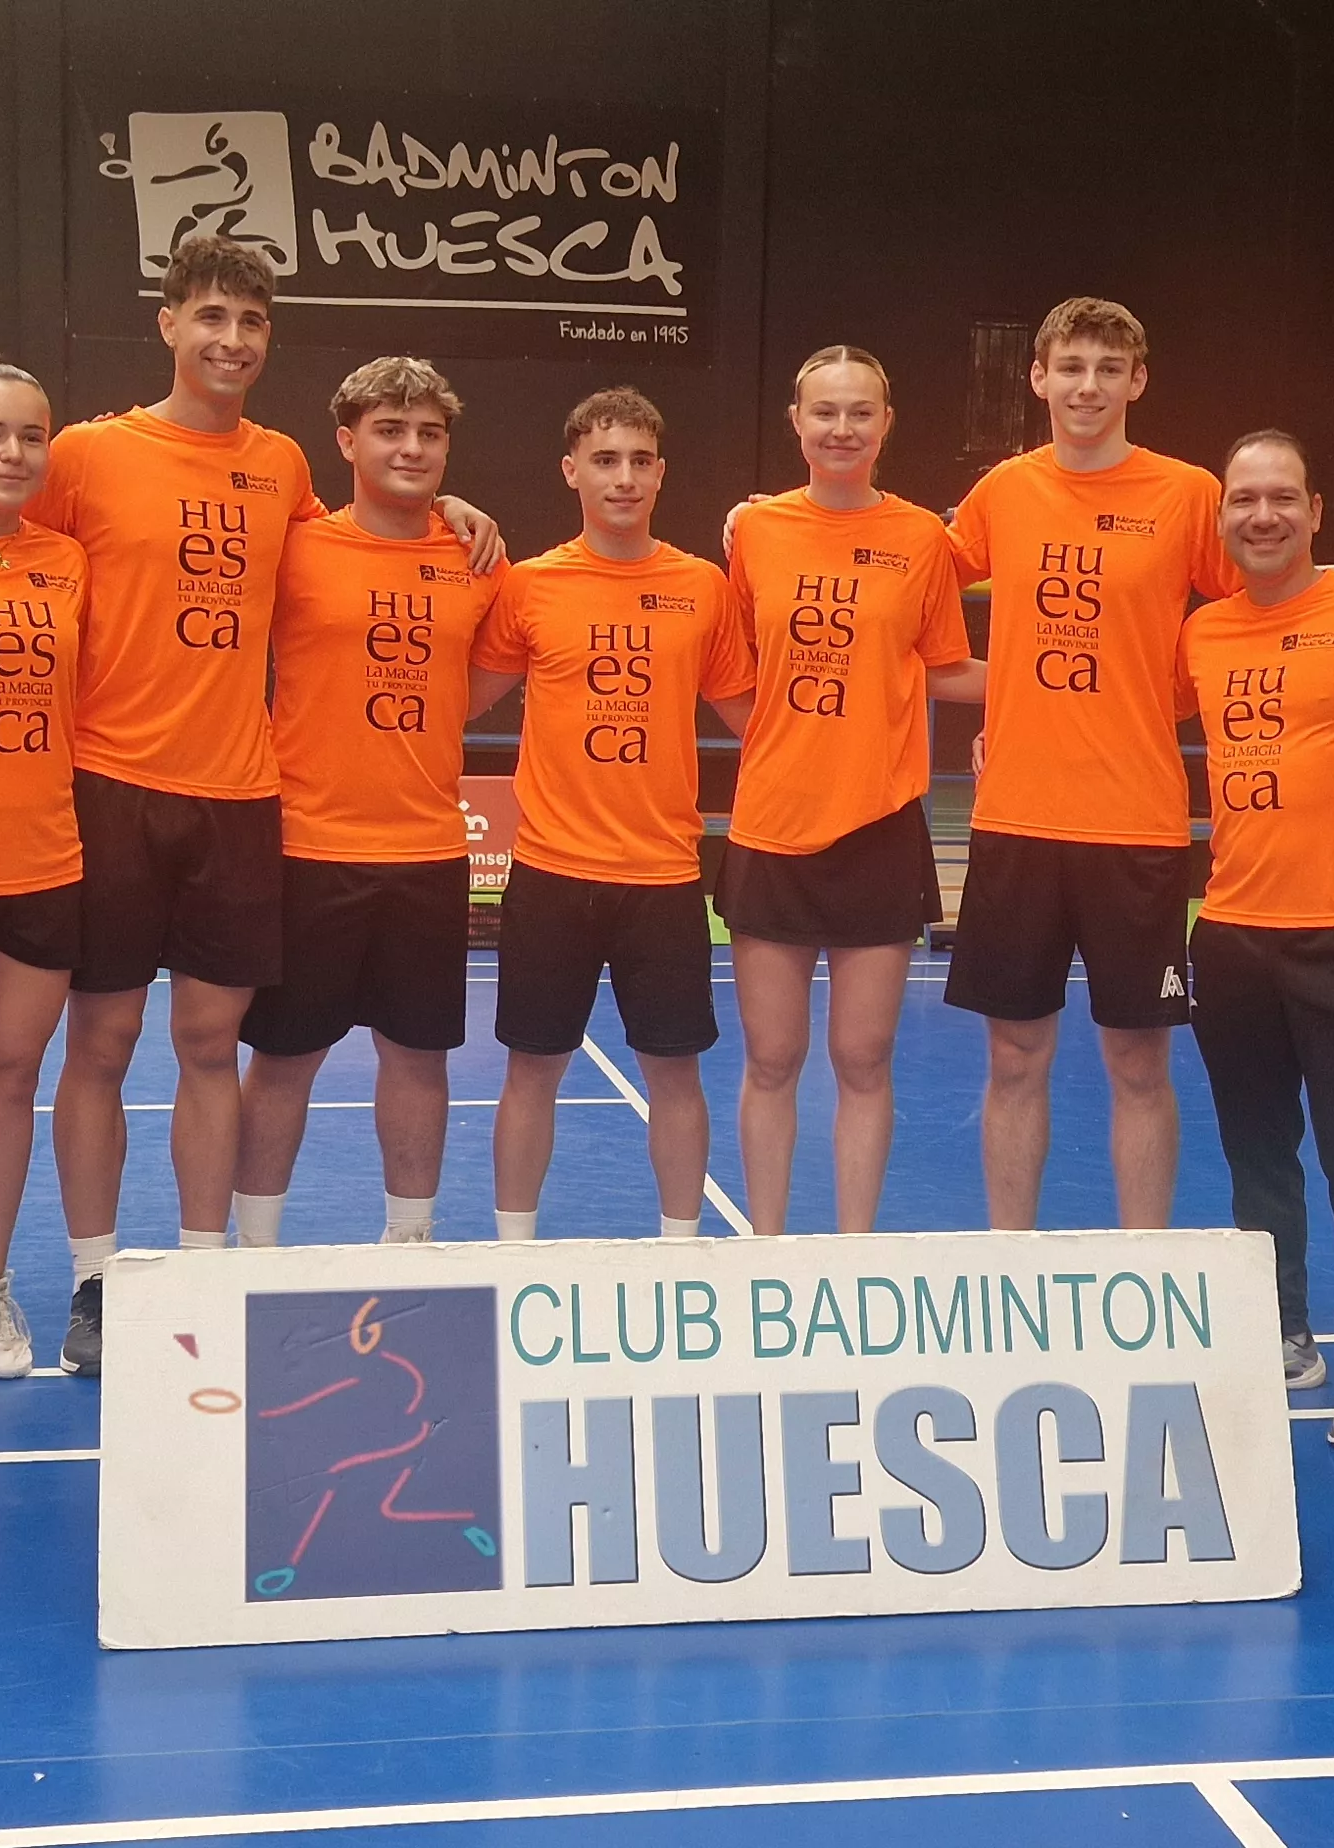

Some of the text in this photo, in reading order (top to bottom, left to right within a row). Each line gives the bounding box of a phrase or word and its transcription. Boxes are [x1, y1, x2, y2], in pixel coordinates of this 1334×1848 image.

[311, 208, 684, 296] HUESCA
[559, 320, 689, 344] Fundado en 1995
[178, 533, 247, 579] es
[1036, 576, 1101, 623] es
[366, 622, 432, 665] es
[789, 605, 855, 649] es
[587, 655, 652, 697] es
[1223, 698, 1285, 743] es
[509, 1270, 1213, 1367] CLUB BADMINTON
[519, 1380, 1237, 1588] HUESCA
